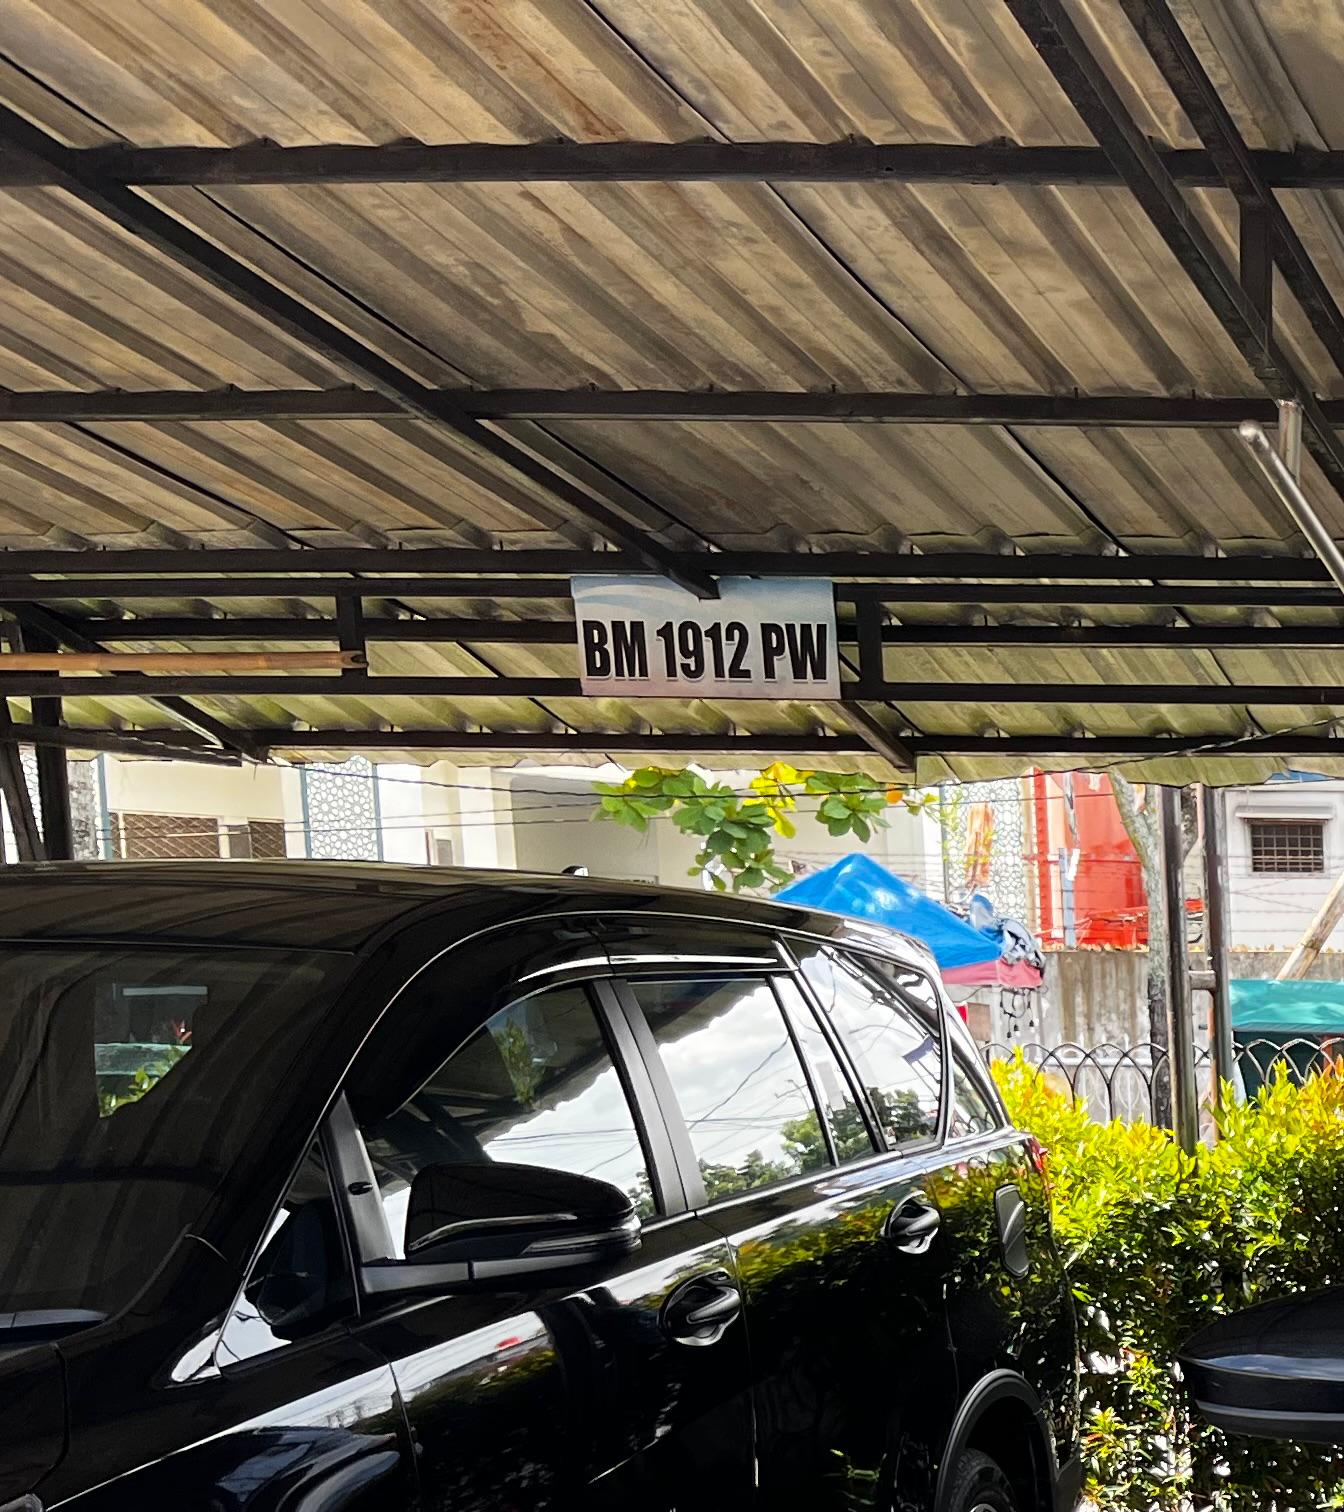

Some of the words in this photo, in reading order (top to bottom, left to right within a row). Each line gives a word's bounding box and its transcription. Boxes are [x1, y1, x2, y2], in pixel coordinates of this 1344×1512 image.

[581, 619, 649, 679] BM
[656, 620, 751, 680] 1912
[760, 622, 827, 682] PW
